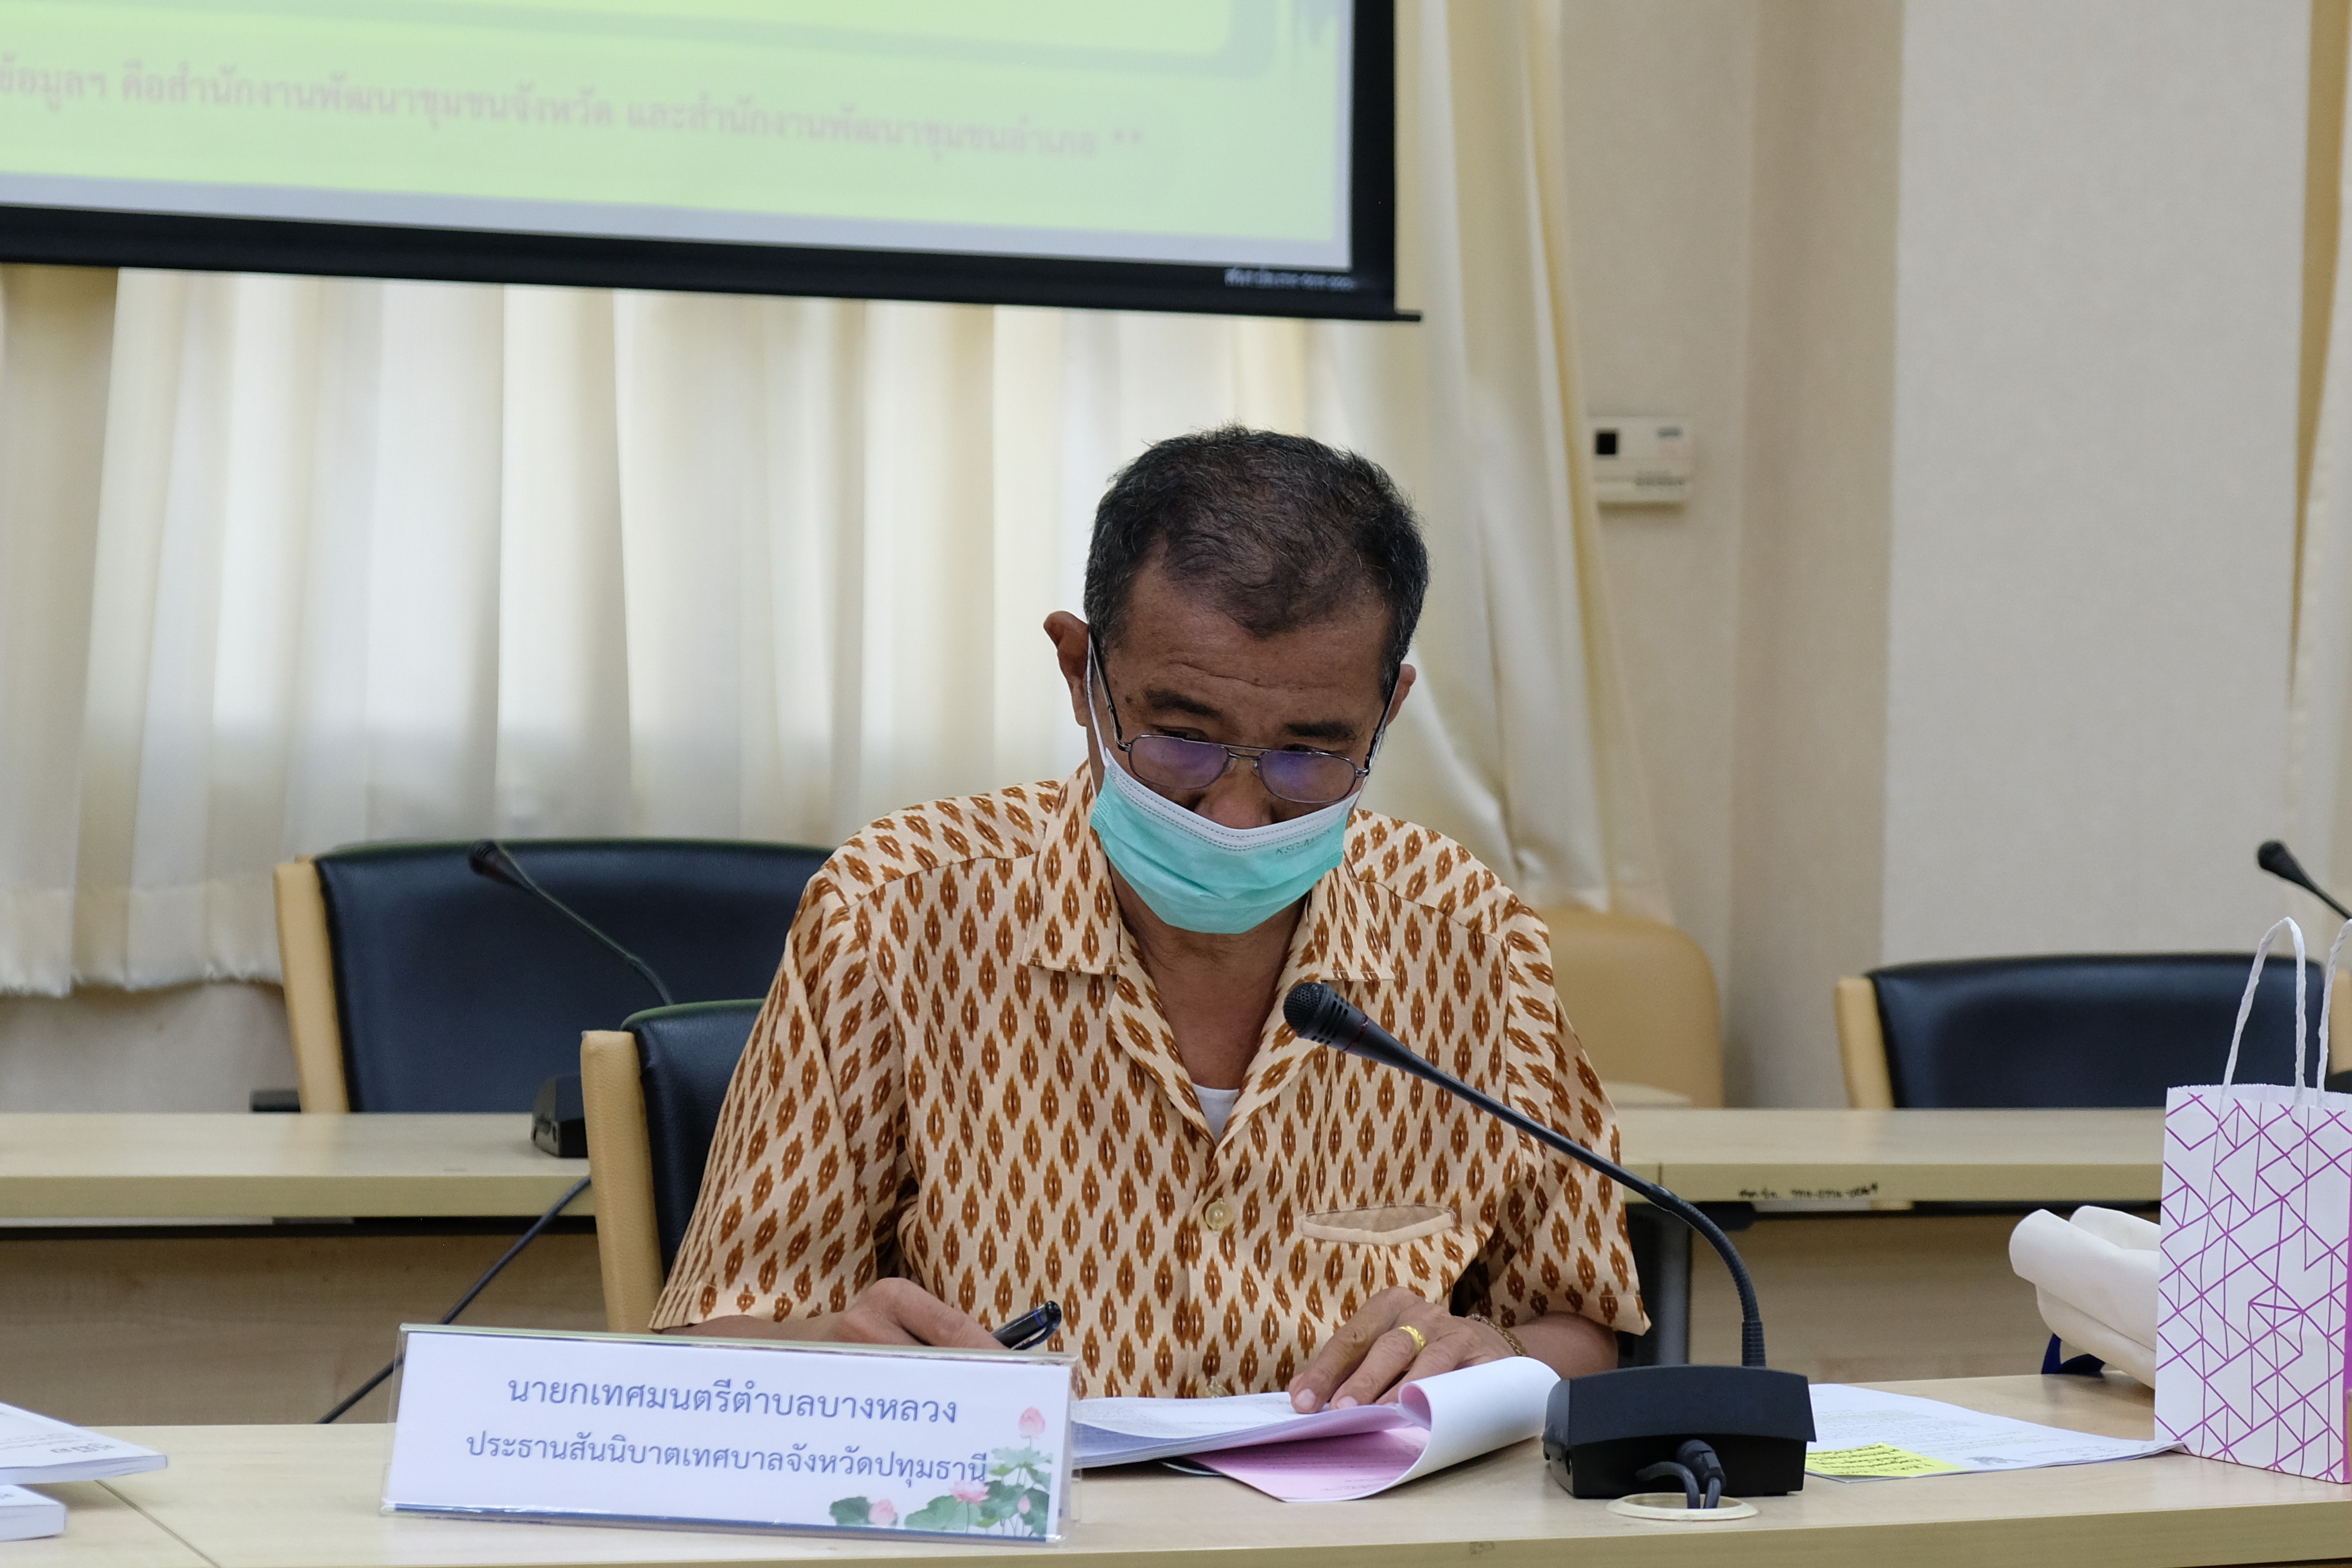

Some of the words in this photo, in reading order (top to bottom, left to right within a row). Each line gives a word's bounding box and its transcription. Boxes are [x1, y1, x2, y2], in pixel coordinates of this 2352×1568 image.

[507, 1378, 957, 1423] นายกเทศมนตรีตำบลบางหลวง
[466, 1430, 987, 1488] ประธานสันนิบาตเทศบาลจังหวัดปทุมธานี
